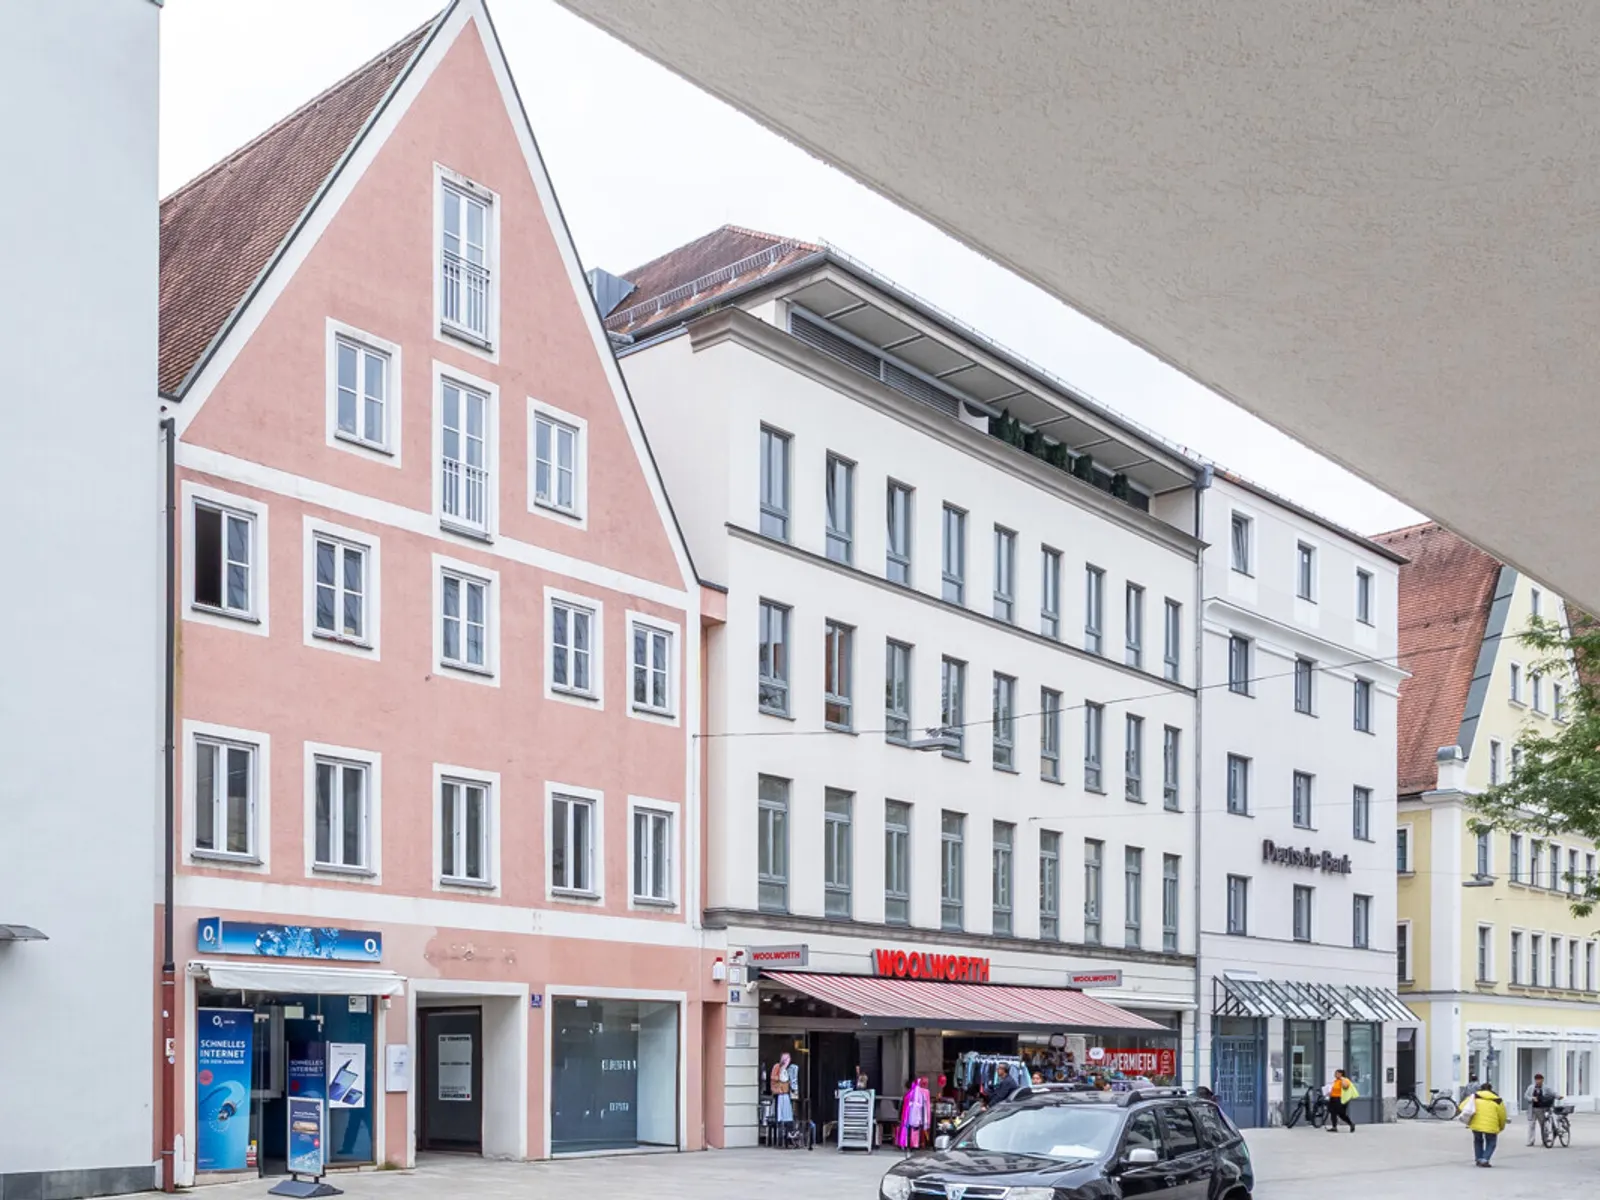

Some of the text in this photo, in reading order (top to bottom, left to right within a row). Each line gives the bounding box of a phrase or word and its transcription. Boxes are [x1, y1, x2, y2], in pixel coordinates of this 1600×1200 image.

[1262, 839, 1353, 875] Deutsche Bank
[752, 951, 801, 960] WOOLWORTH
[874, 948, 990, 982] WOOLWORTH
[1072, 974, 1117, 982] WOOLWORTH
[200, 1040, 246, 1048] SCHNELLES
[200, 1049, 245, 1058] INTERNET
